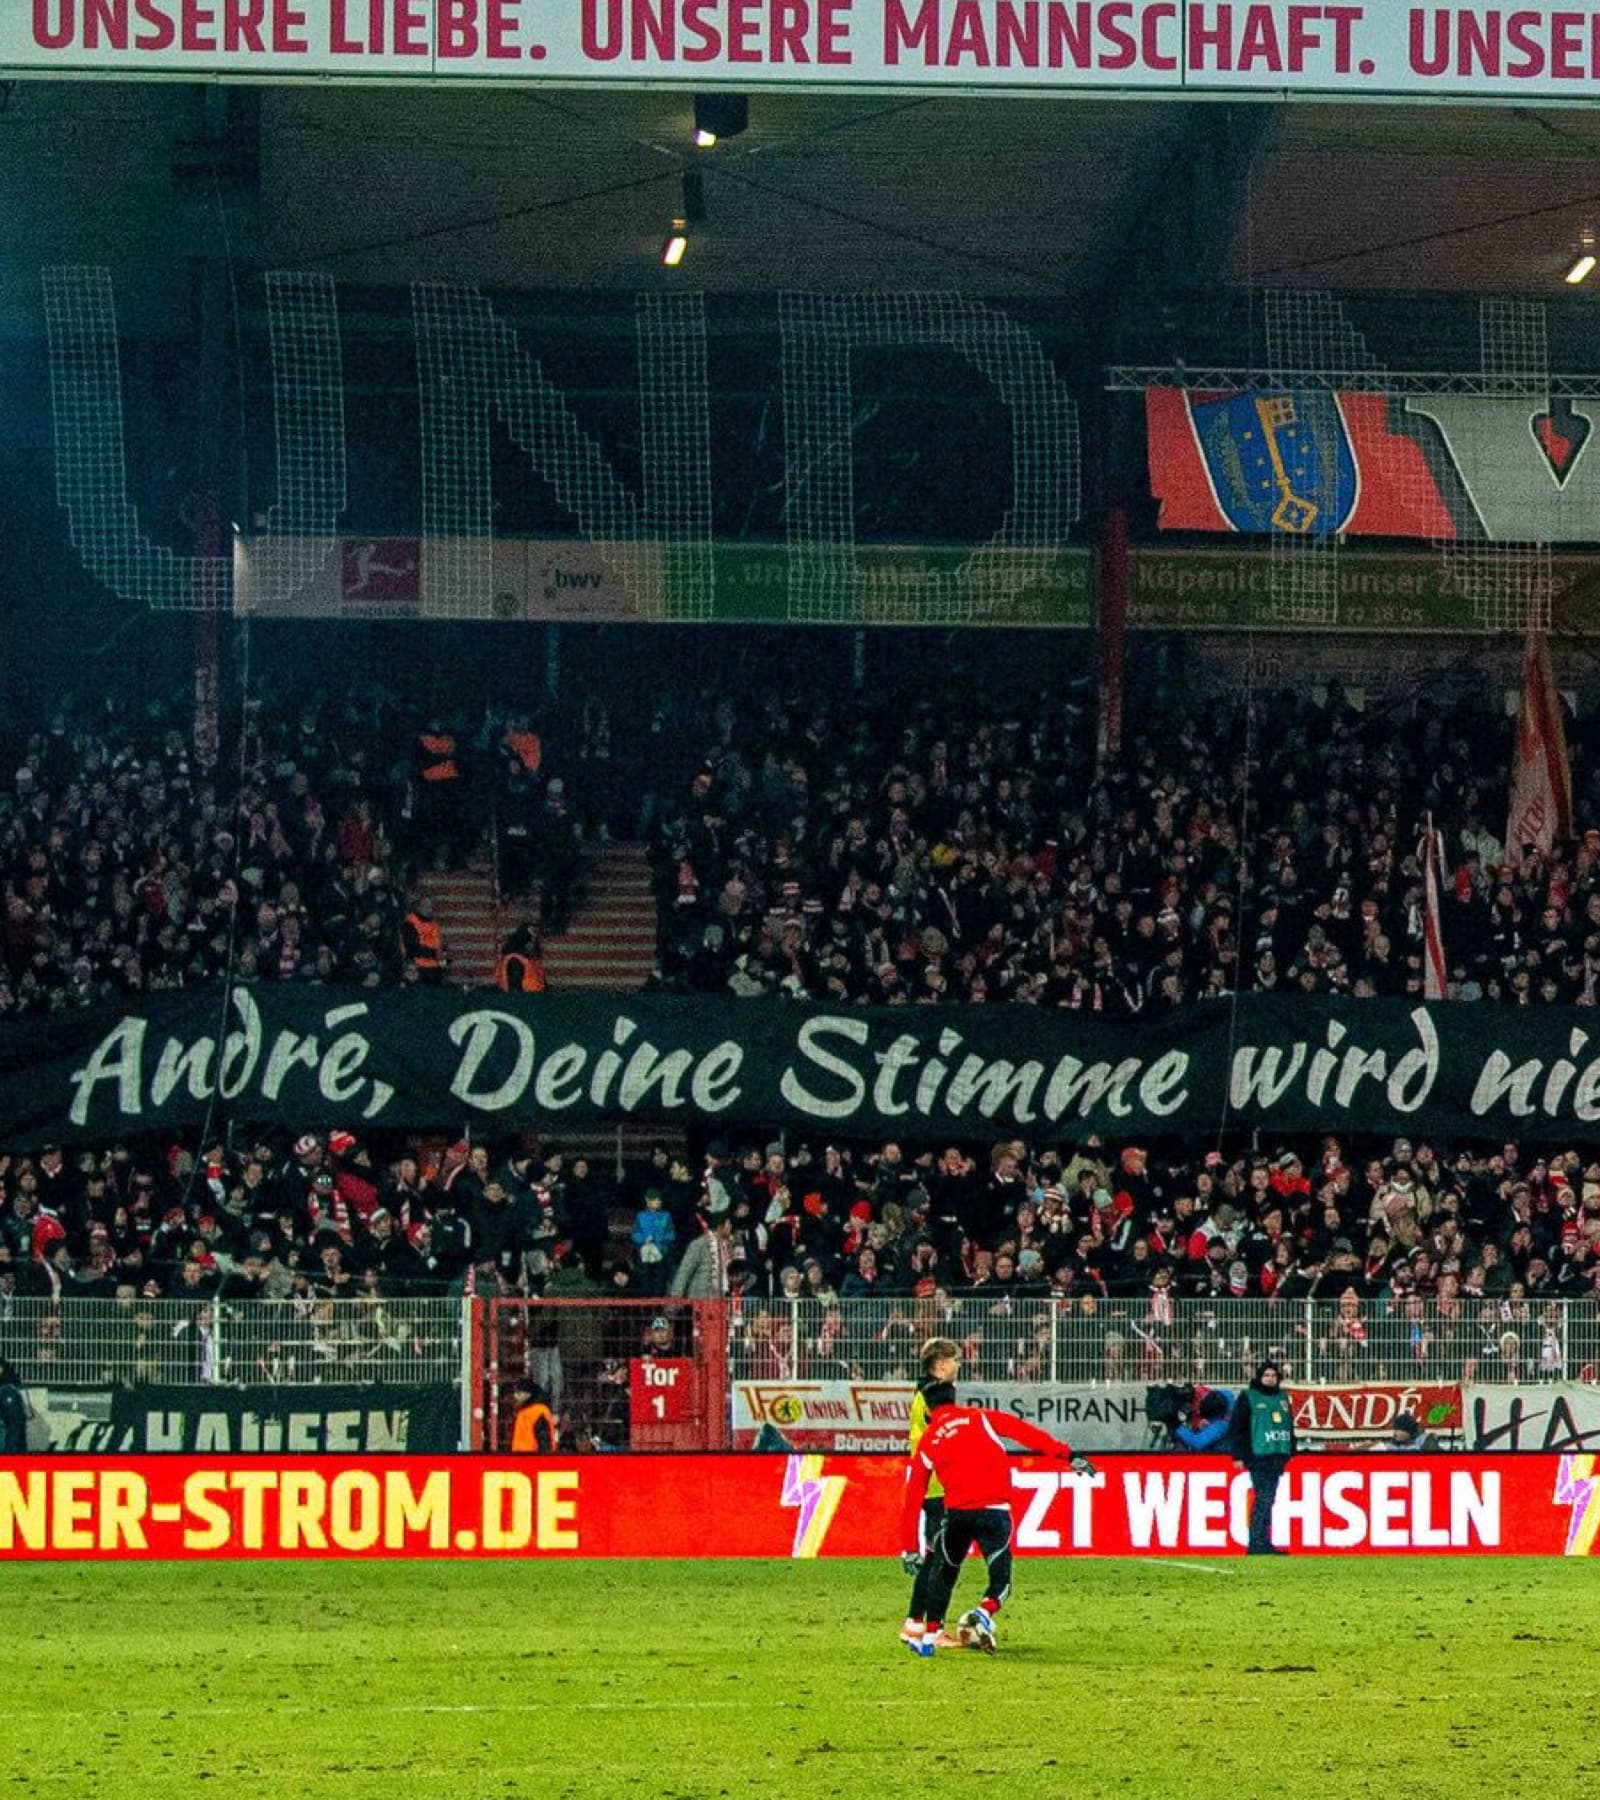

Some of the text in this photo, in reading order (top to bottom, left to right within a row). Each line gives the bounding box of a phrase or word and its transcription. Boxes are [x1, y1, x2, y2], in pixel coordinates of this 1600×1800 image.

[31, 0, 308, 52] UNSERE
[329, 0, 546, 60] LIEBE.
[580, 0, 852, 65] UNSERE
[884, 0, 1375, 75] MANNSCHAFT.
[554, 568, 602, 589] bwv
[1341, 569, 1427, 596] unser
[69, 985, 395, 1127] André,
[447, 1009, 745, 1113] Deine
[779, 1014, 1190, 1123] Stimme
[1229, 1006, 1440, 1113] wird
[641, 1364, 680, 1387] Tor
[651, 1396, 666, 1418] 1
[851, 1386, 914, 1422] FANCLU
[967, 1396, 1148, 1426] ILS-PIRANH
[1290, 1388, 1423, 1430] ANDÉ
[0, 1469, 579, 1551] NER-STROM.DE
